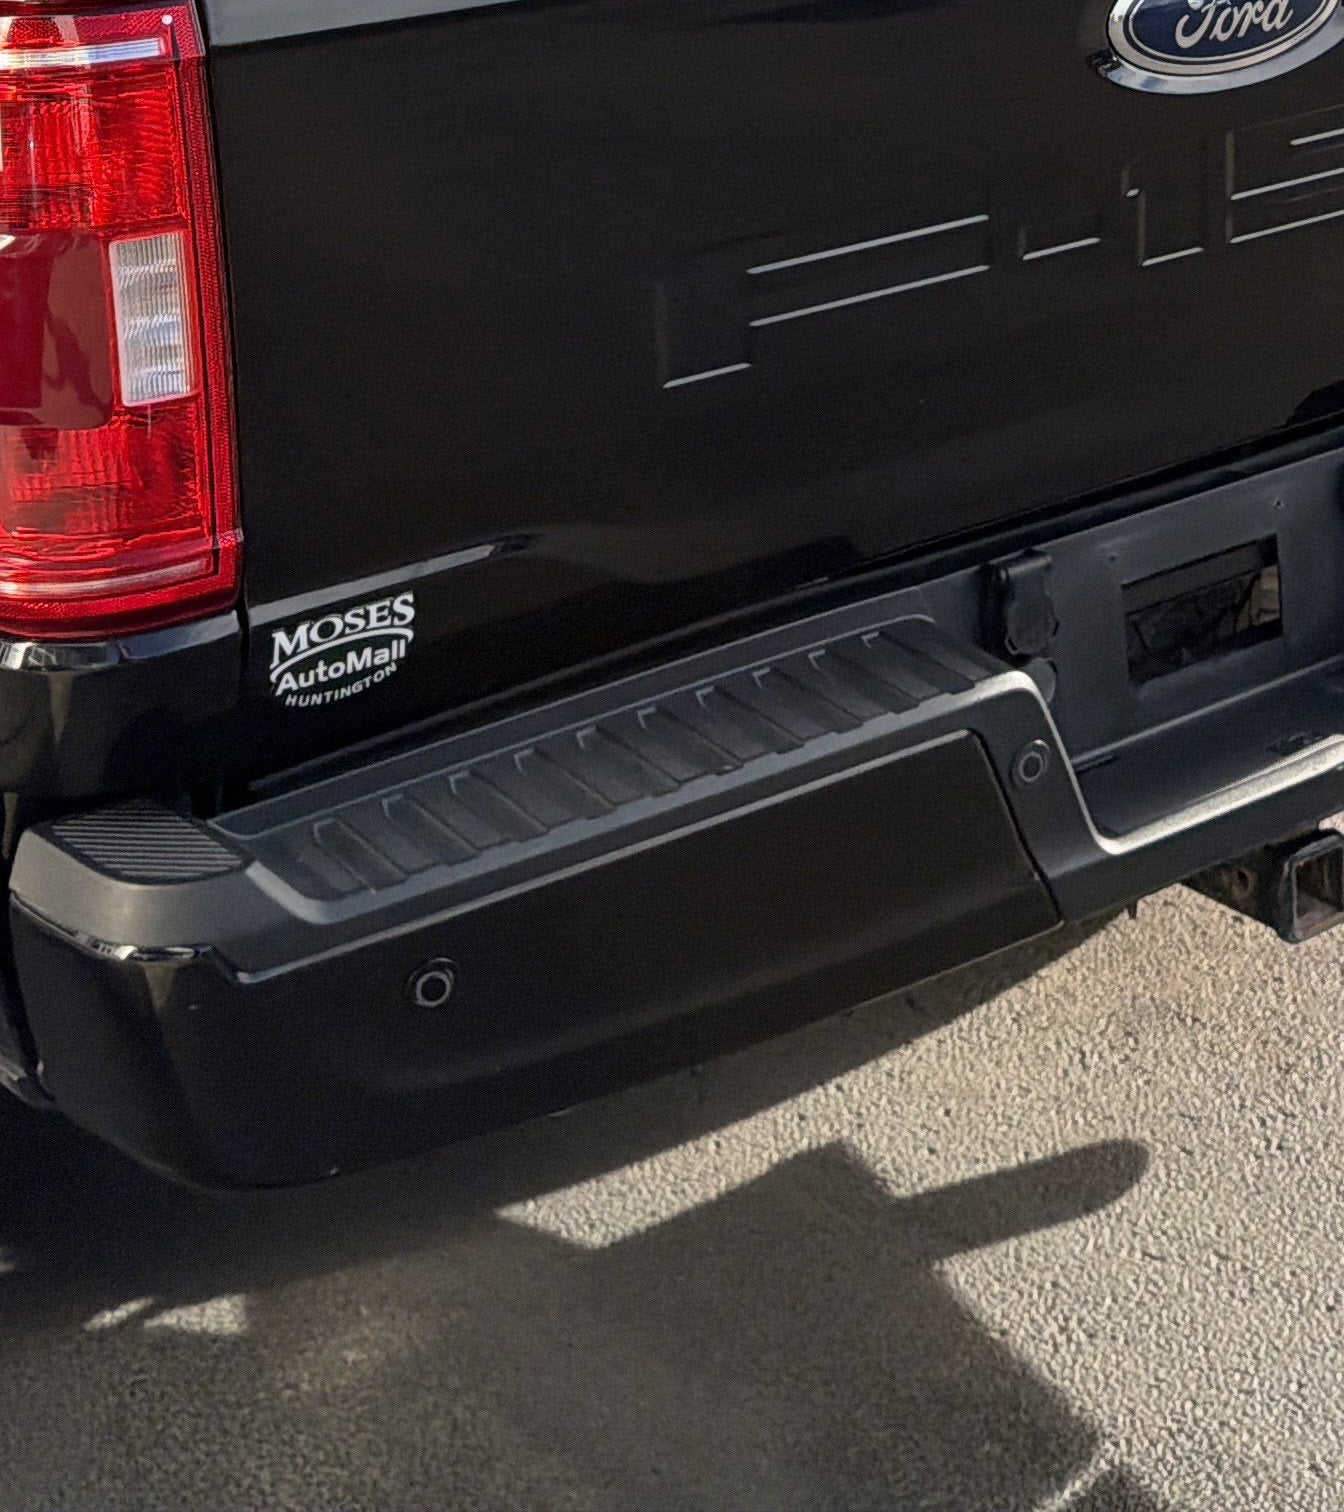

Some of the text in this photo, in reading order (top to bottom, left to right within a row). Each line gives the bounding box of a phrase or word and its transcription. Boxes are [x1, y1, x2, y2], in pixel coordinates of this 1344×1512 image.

[269, 591, 415, 670] MOSES
[275, 638, 406, 696] AutoMall
[285, 662, 397, 707] HUNTINGTON
